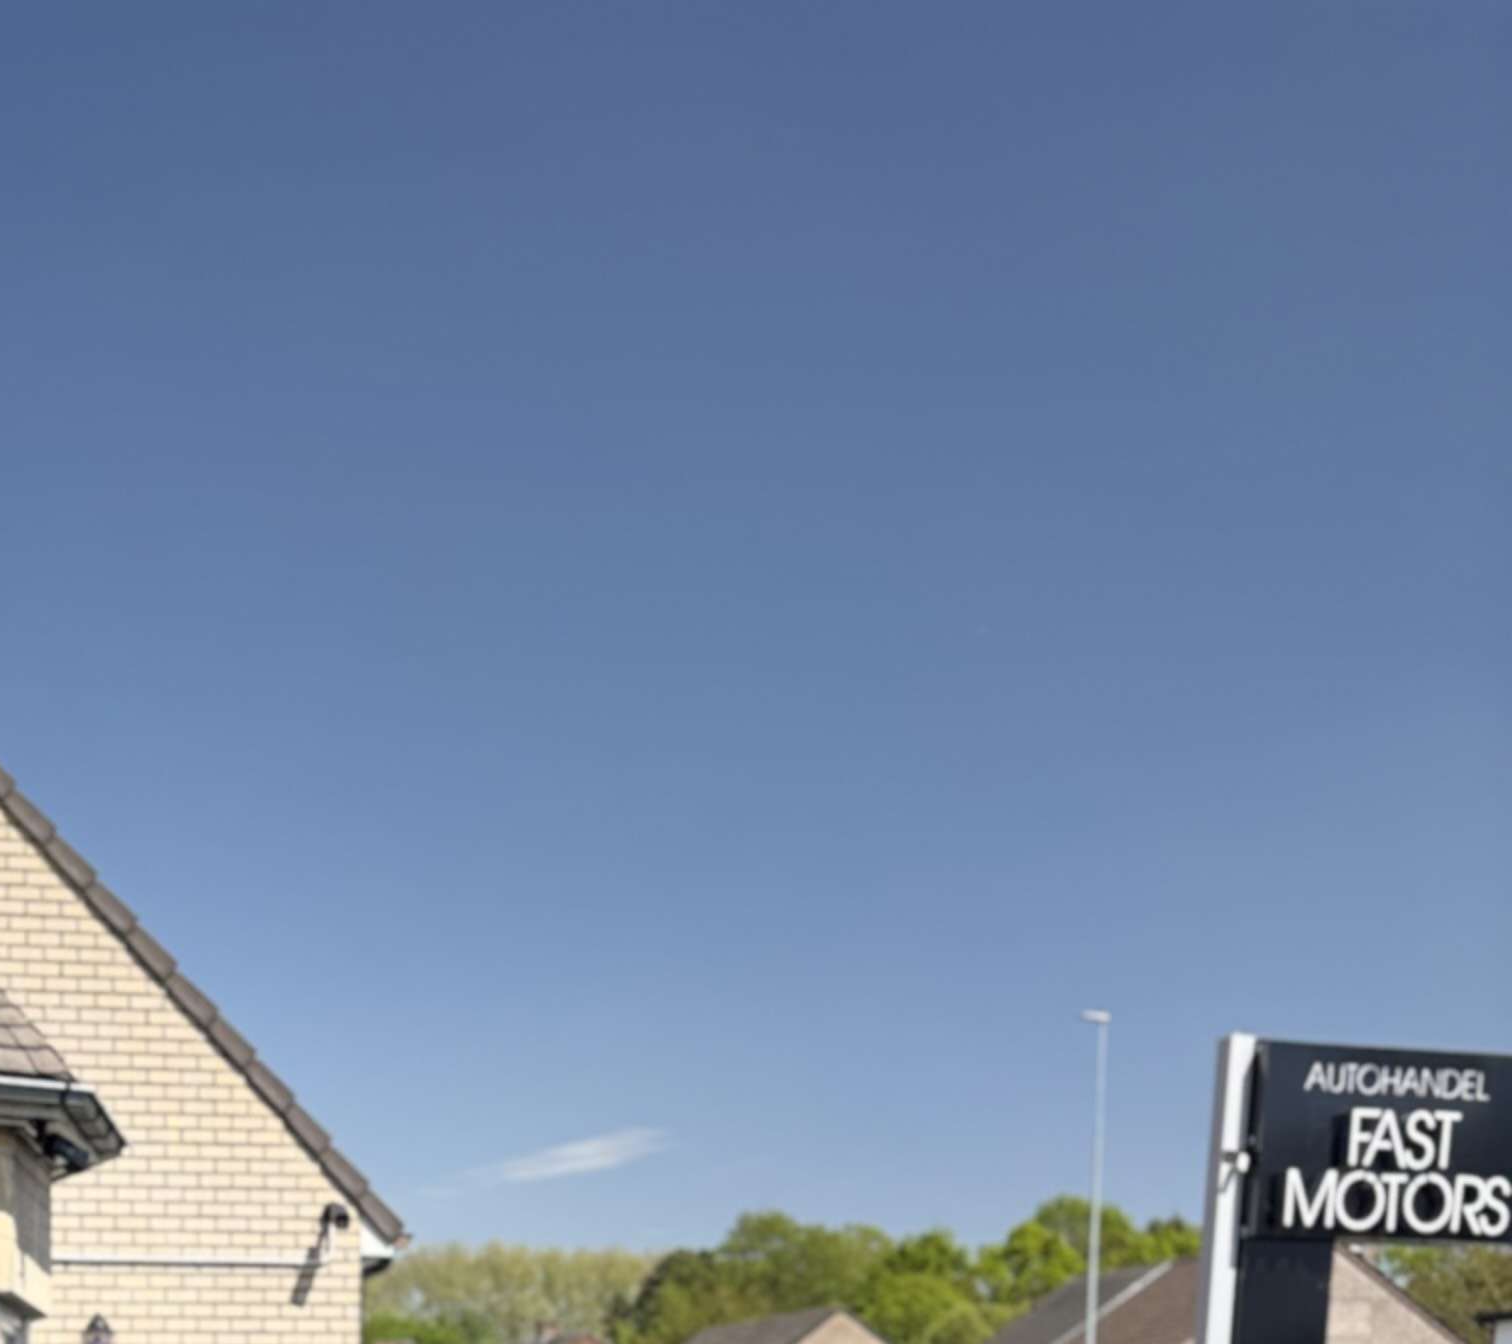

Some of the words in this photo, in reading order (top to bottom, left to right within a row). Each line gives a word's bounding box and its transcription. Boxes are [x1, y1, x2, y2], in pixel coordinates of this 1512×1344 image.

[1303, 1061, 1490, 1102] AUTOHANDEL
[1347, 1106, 1463, 1171] FAST
[1282, 1167, 1511, 1237] MOTORS
